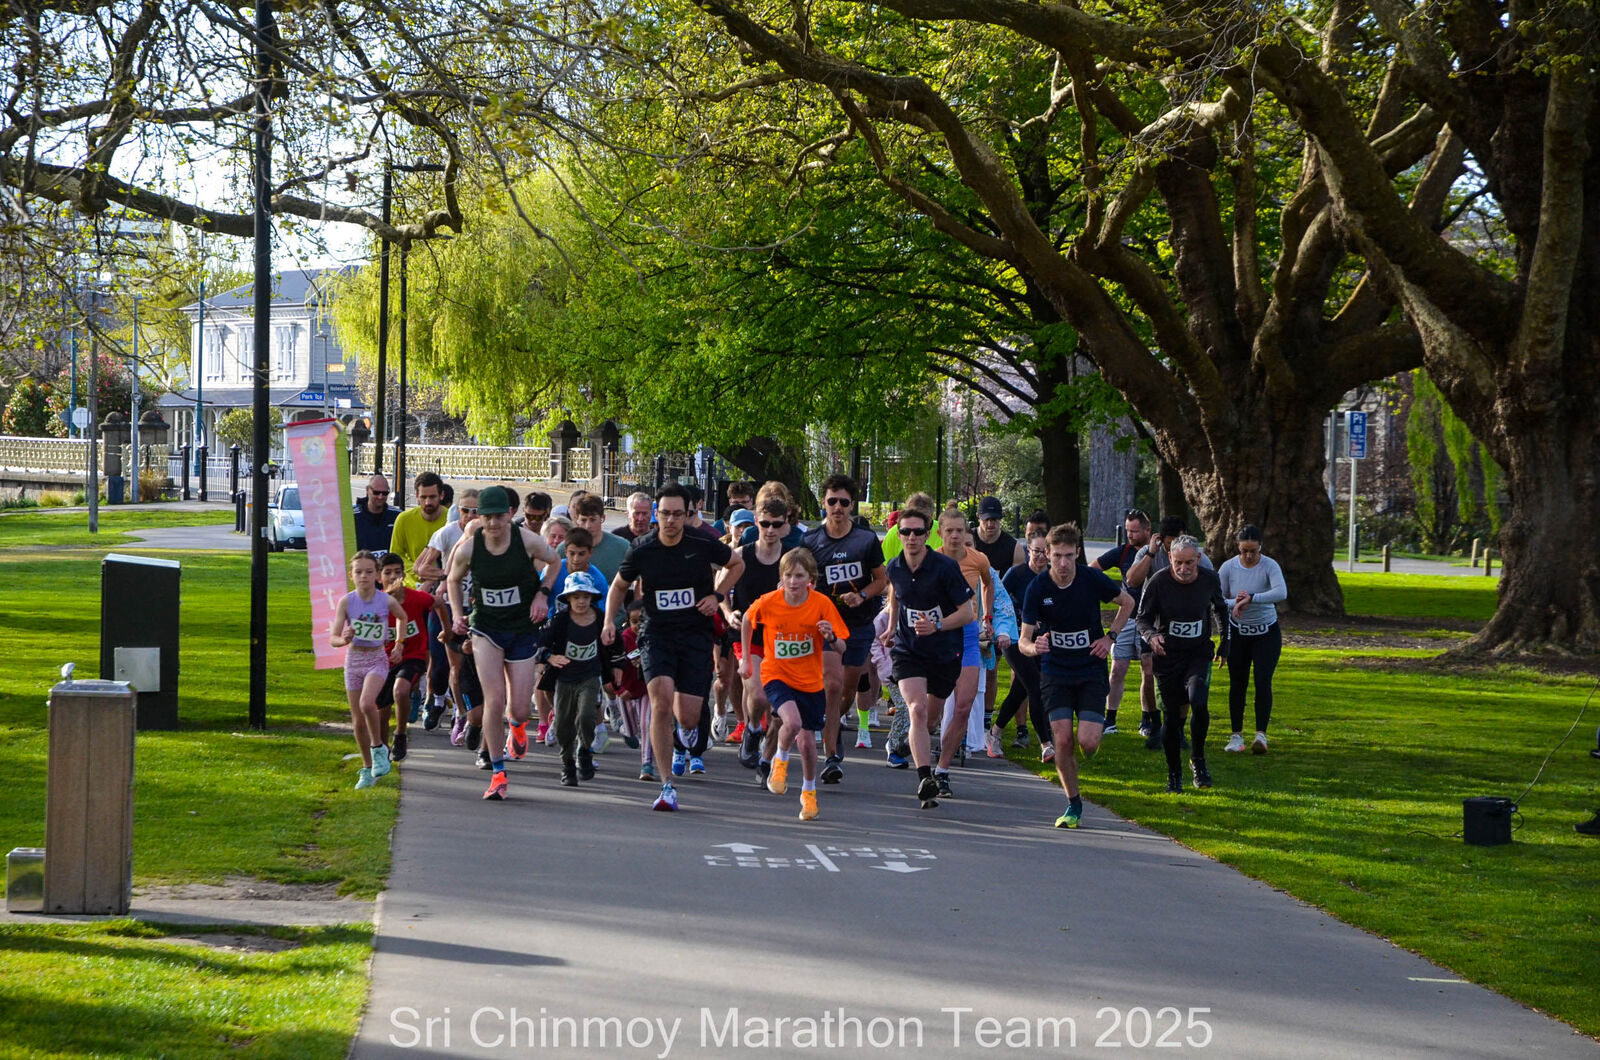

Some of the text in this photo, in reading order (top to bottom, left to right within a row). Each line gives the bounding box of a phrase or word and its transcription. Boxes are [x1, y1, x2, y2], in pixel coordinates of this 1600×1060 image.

[830, 564, 859, 581] 510
[486, 590, 515, 604] 517
[659, 590, 692, 607] 540
[353, 621, 383, 639] 373
[388, 623, 416, 639] 38
[1172, 623, 1199, 636] 521
[1241, 624, 1267, 634] 550
[1054, 633, 1087, 647] 556
[568, 643, 596, 658] 372
[777, 642, 811, 657] 369
